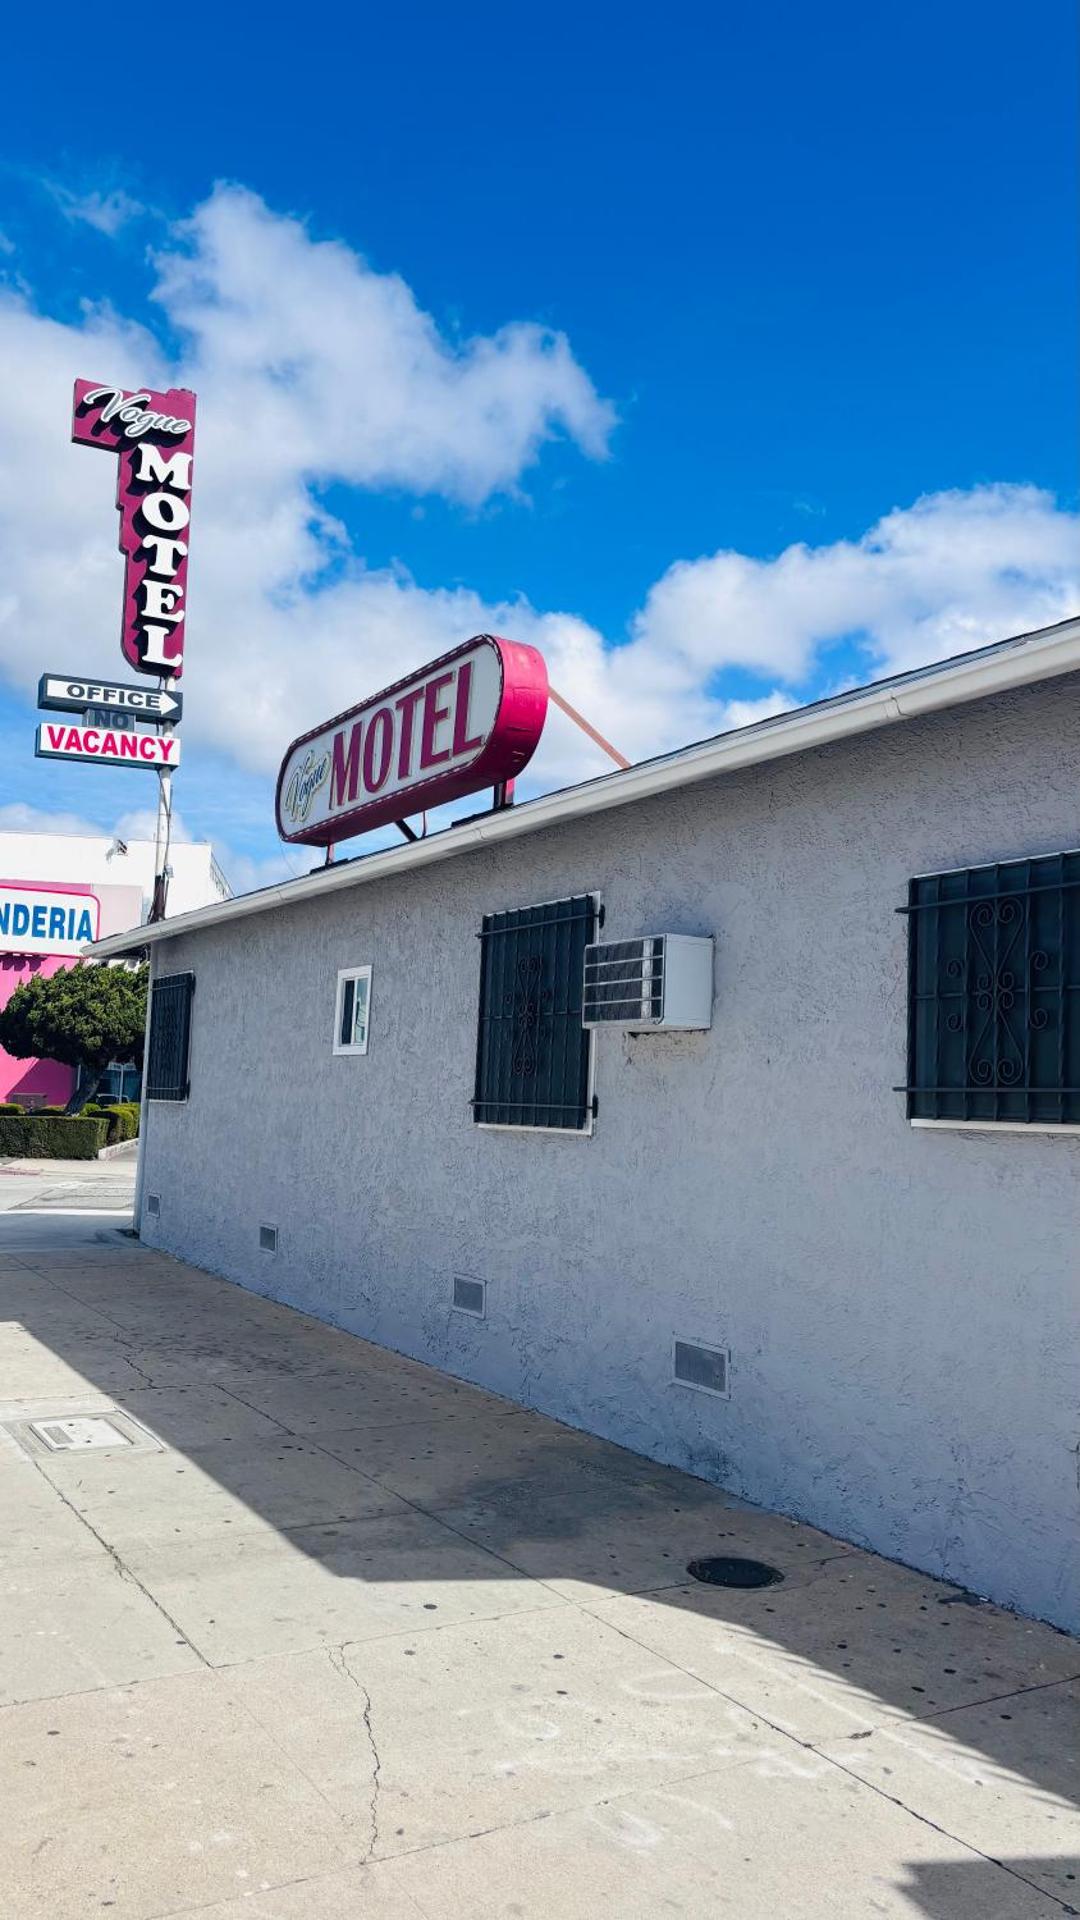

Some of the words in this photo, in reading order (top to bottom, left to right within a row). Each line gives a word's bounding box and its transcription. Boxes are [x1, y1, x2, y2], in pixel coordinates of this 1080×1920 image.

[82, 387, 192, 438] Vogue
[135, 442, 193, 668] MOTEL
[66, 684, 161, 709] OFFICE
[95, 710, 129, 729] NO
[329, 661, 485, 810] MOTEL
[46, 725, 174, 761] VACANCY
